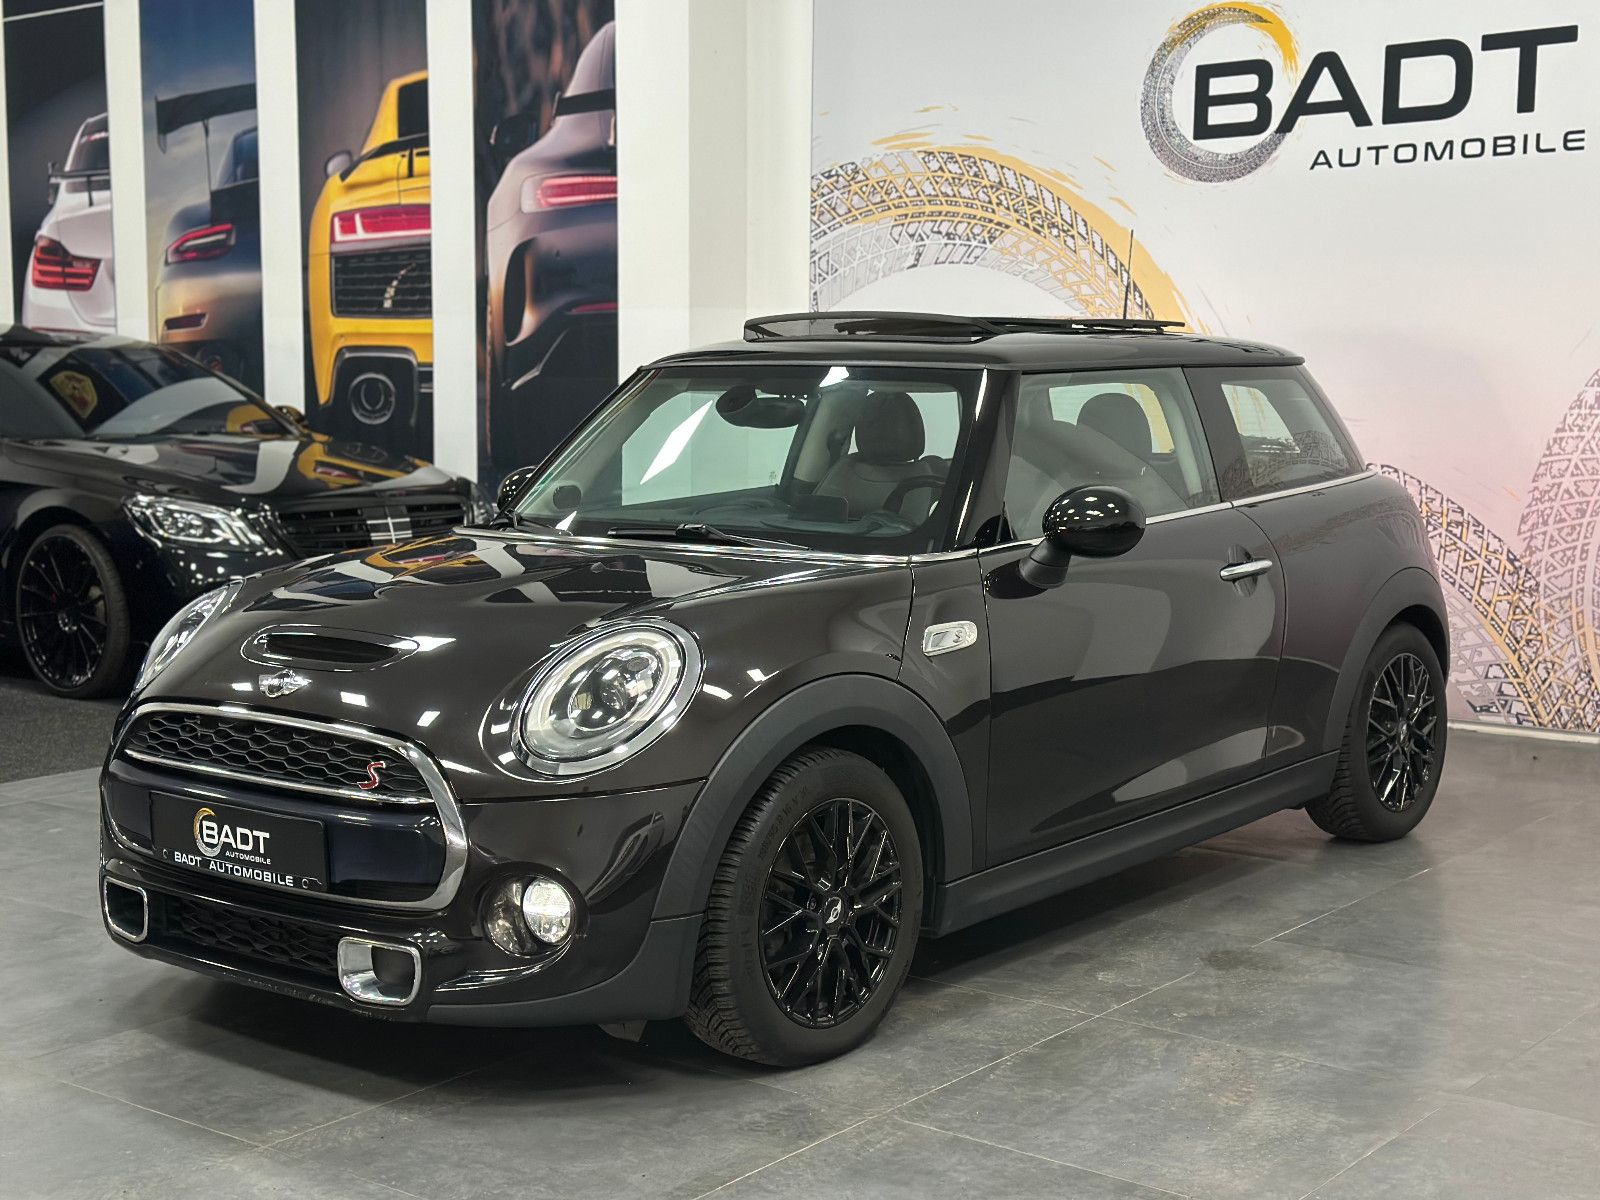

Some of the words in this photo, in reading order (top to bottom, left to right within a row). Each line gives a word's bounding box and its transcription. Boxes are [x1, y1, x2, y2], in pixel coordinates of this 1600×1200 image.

[1192, 25, 1578, 141] BADT
[1309, 129, 1586, 171] AUTOMOBILE
[356, 760, 386, 790] S
[202, 820, 270, 854] BADT
[174, 851, 202, 867] BADT
[209, 860, 294, 887] AUTOMOBILE
[225, 850, 271, 865] AUTOMOBILE
